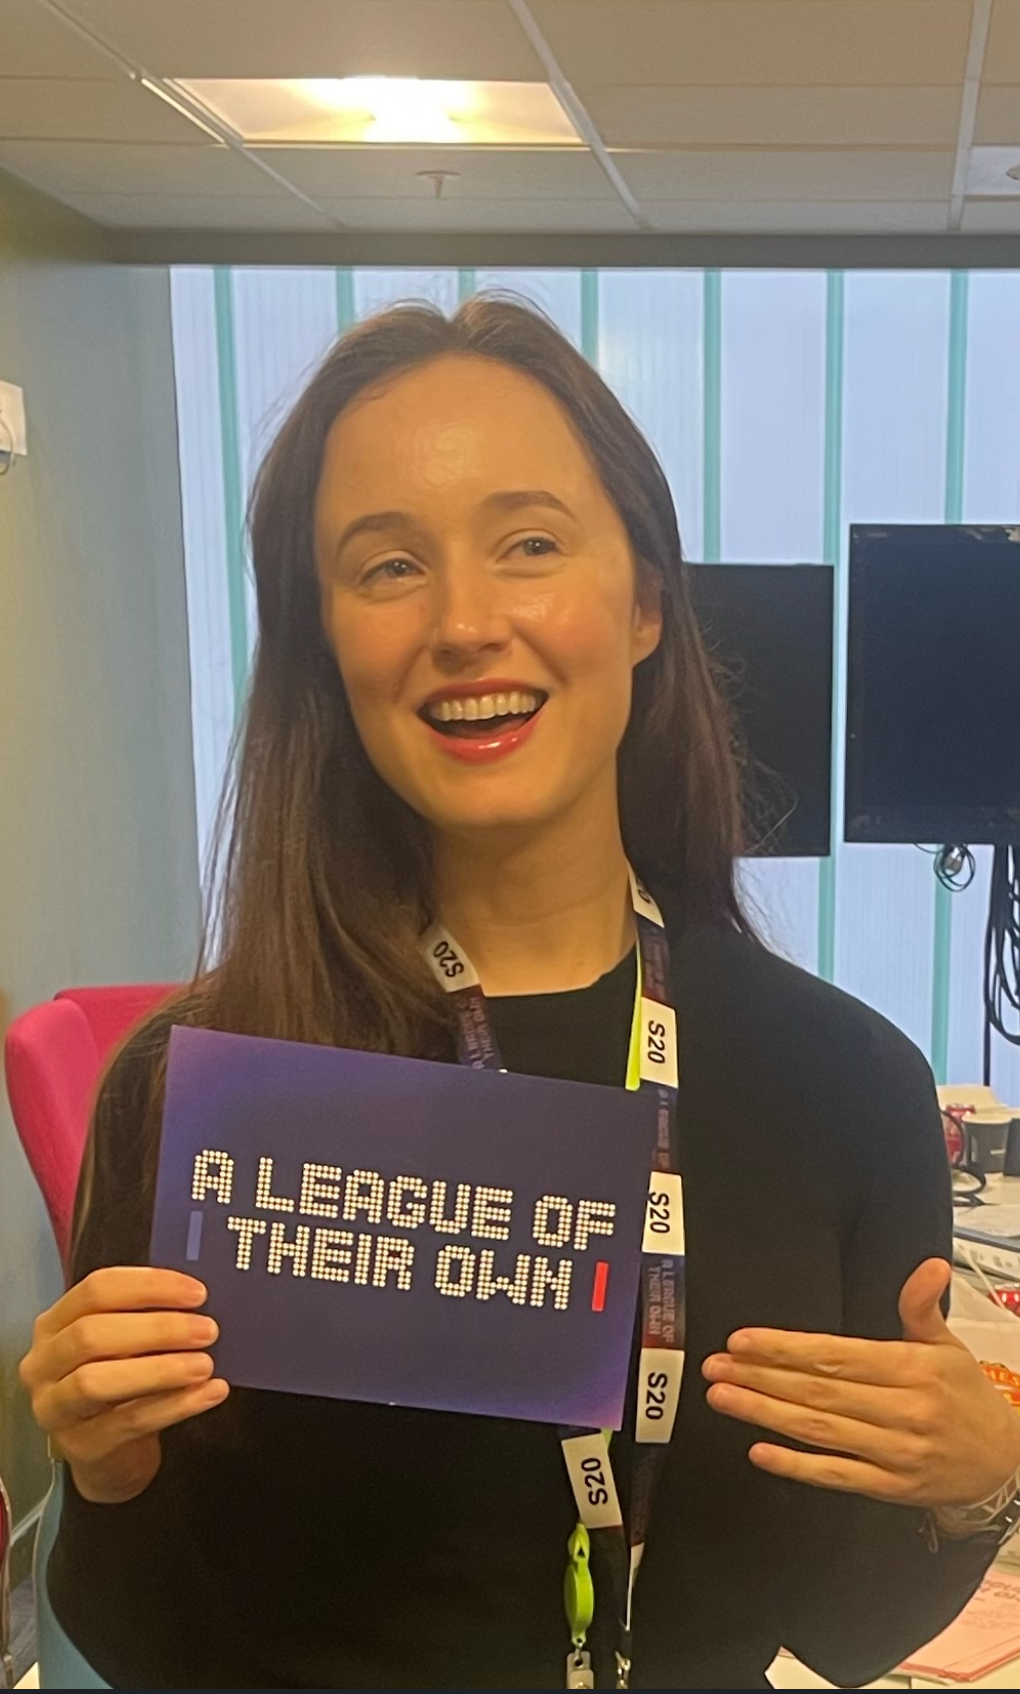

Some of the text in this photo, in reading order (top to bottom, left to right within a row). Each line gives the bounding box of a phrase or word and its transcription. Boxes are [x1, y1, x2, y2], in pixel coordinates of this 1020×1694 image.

[432, 941, 465, 978] S20
[647, 1020, 666, 1064] S20
[191, 1149, 616, 1250] A LEAGUE OF
[648, 1191, 670, 1234] S20
[226, 1215, 573, 1311] THEIR OWN
[645, 1372, 668, 1420] S20
[580, 1457, 608, 1506] S20
